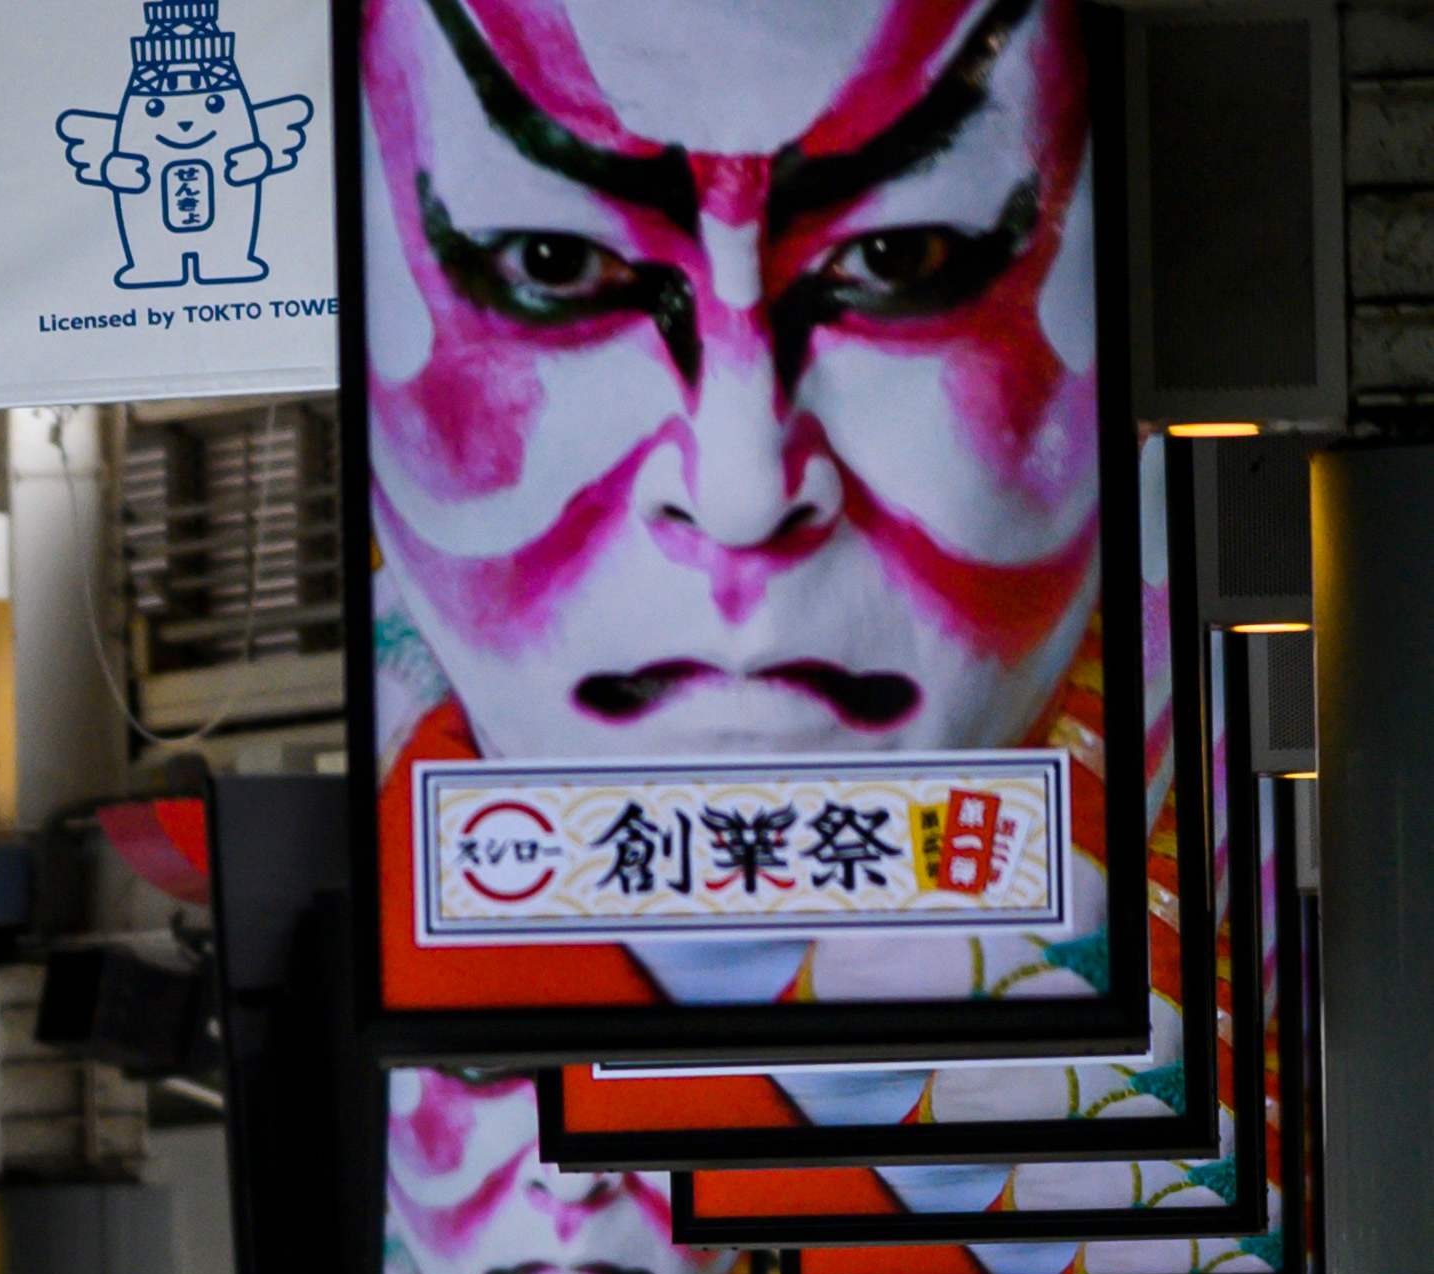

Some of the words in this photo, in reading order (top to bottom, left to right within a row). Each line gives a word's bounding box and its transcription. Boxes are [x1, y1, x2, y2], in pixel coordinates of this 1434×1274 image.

[174, 167, 201, 225] せんきょ
[38, 308, 137, 332] Licensed
[147, 307, 175, 329] by
[456, 838, 563, 864] スシロー
[591, 798, 903, 897] 創業祭
